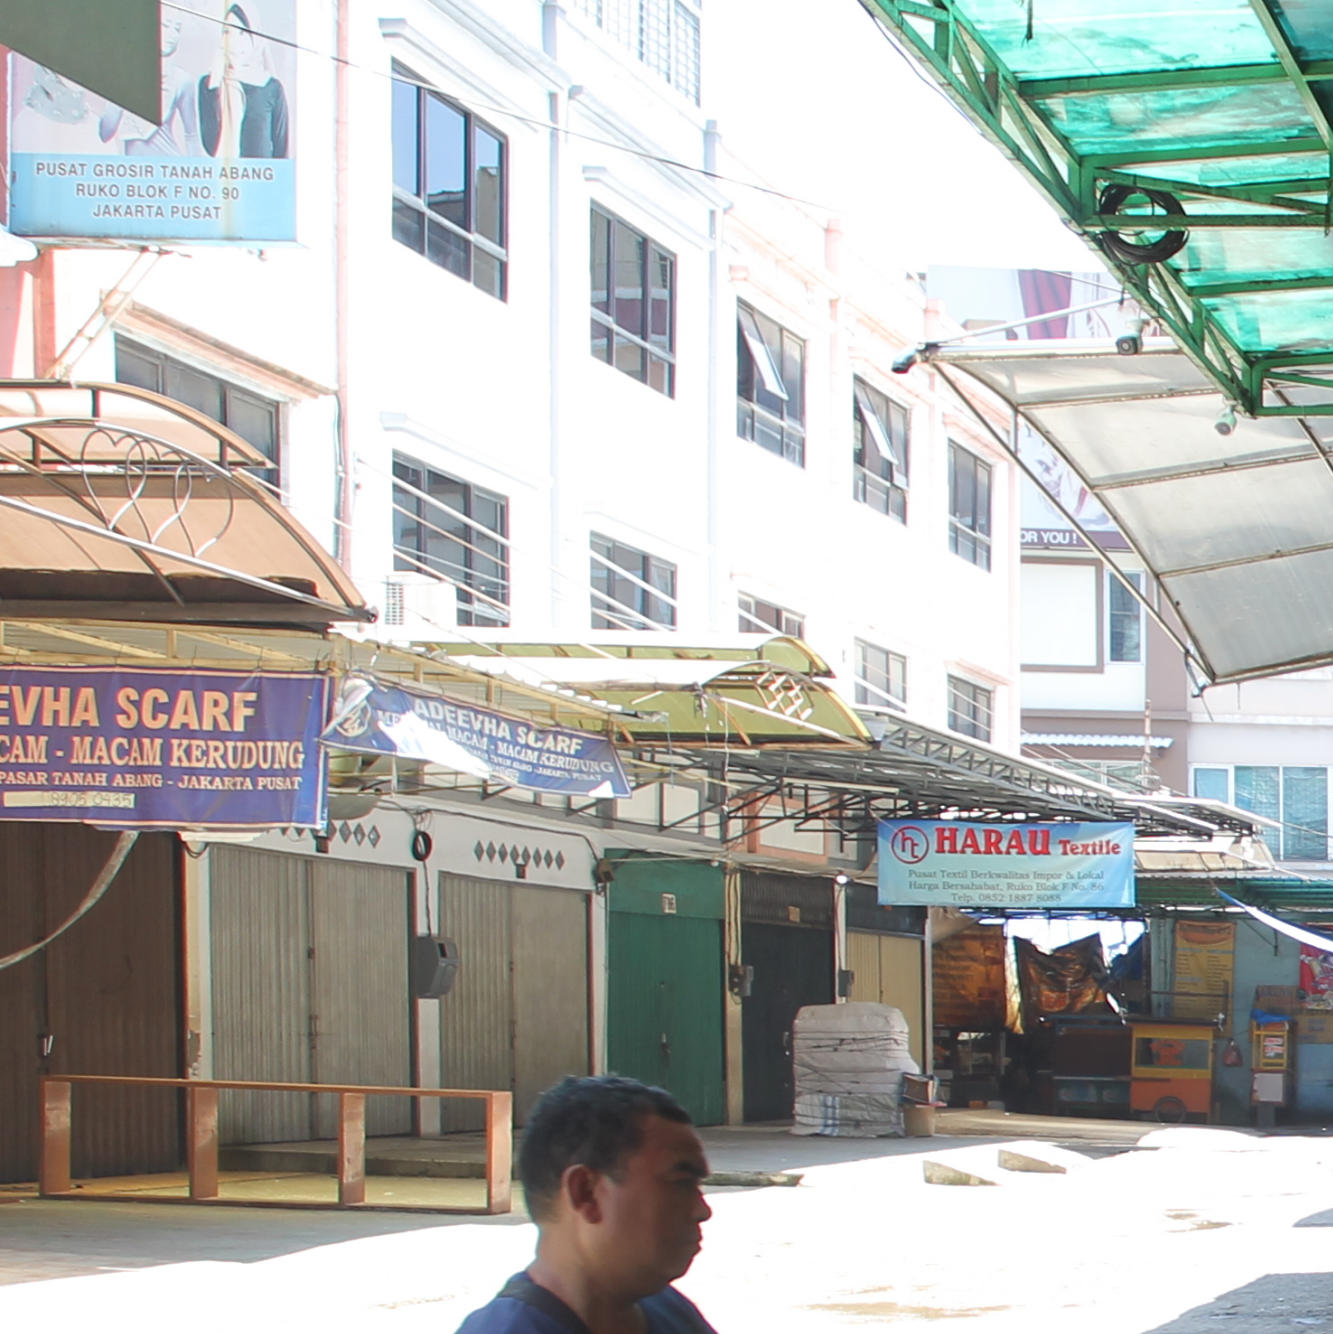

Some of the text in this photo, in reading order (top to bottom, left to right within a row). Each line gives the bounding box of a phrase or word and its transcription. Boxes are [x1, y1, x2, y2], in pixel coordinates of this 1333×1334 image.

[36, 162, 274, 181] PUSAT GROSIR TANAH ABANG
[76, 184, 240, 200] RUKO BLOK F NO. 90
[93, 204, 221, 220] JAKARTA PUSAT
[1040, 532, 1069, 544] YOU
[116, 687, 257, 732] SCARF
[414, 698, 511, 740] ADEEVHA
[517, 726, 583, 754] SCARF
[70, 736, 163, 766] MACAM
[169, 738, 305, 770] KERUDUNG
[540, 752, 614, 773] KERUDUNG
[52, 771, 107, 786] TANAH
[112, 773, 163, 787] ABANG
[178, 775, 252, 790] JAKARTA
[257, 776, 303, 790] PUSAT
[935, 827, 1052, 855] HARAU
[1058, 839, 1121, 855] Textile
[908, 869, 937, 878] Pusat
[940, 869, 969, 878] Textil
[1033, 871, 1063, 881] Impor
[1077, 870, 1105, 879] Lokal
[908, 880, 939, 891] Harga
[1007, 881, 1033, 890] Ruko
